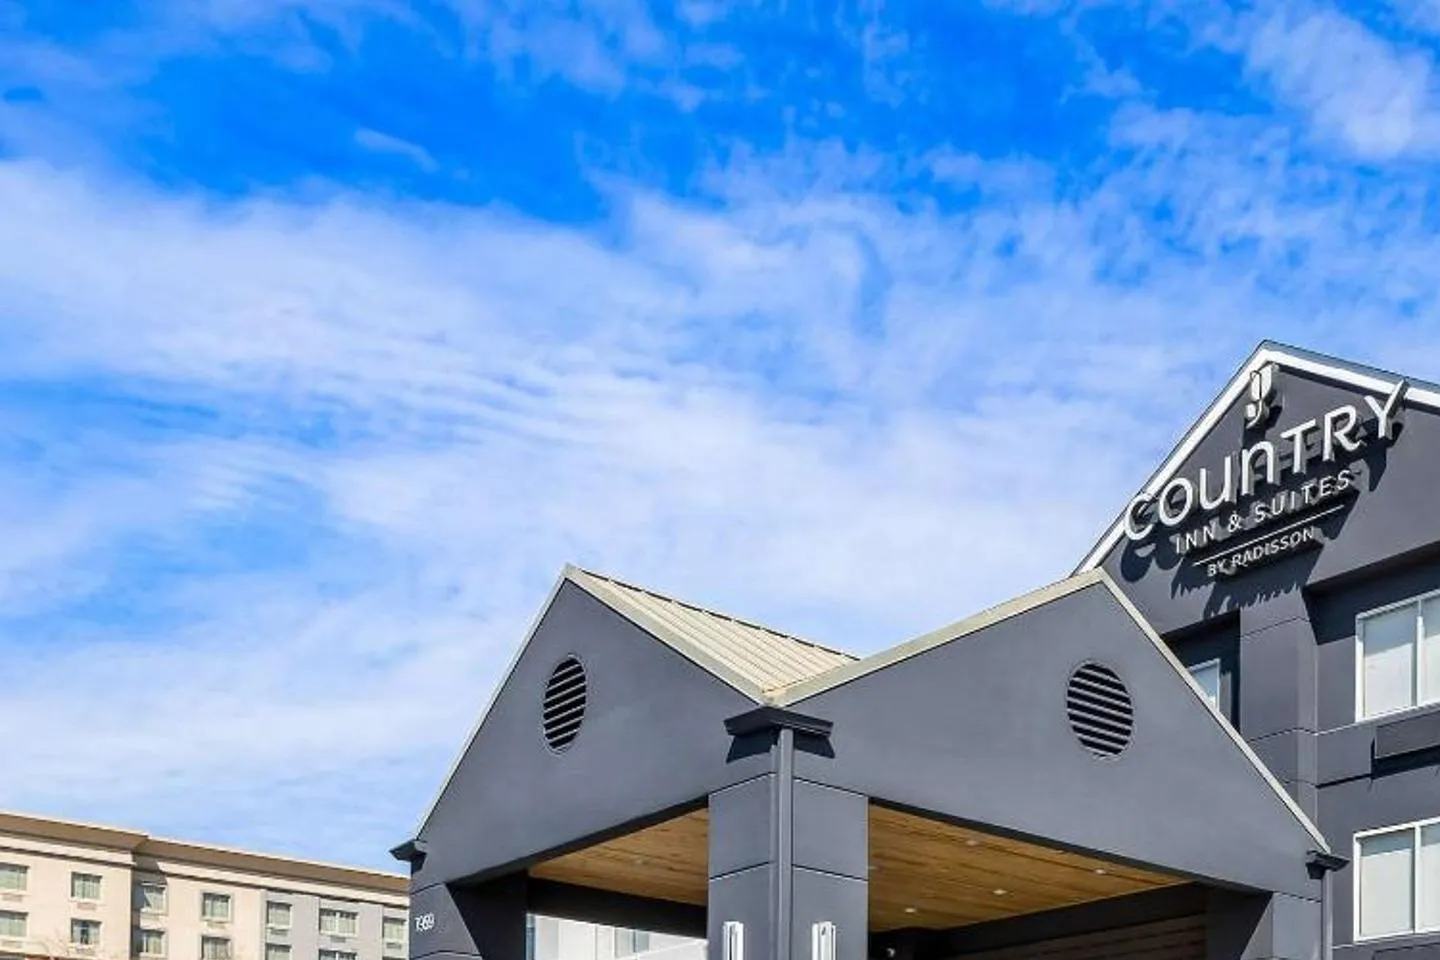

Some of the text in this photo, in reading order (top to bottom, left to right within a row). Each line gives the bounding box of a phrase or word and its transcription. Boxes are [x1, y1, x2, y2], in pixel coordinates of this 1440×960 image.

[1176, 469, 1350, 554] INN & SUITES
[1207, 525, 1315, 577] BY RADISSON
